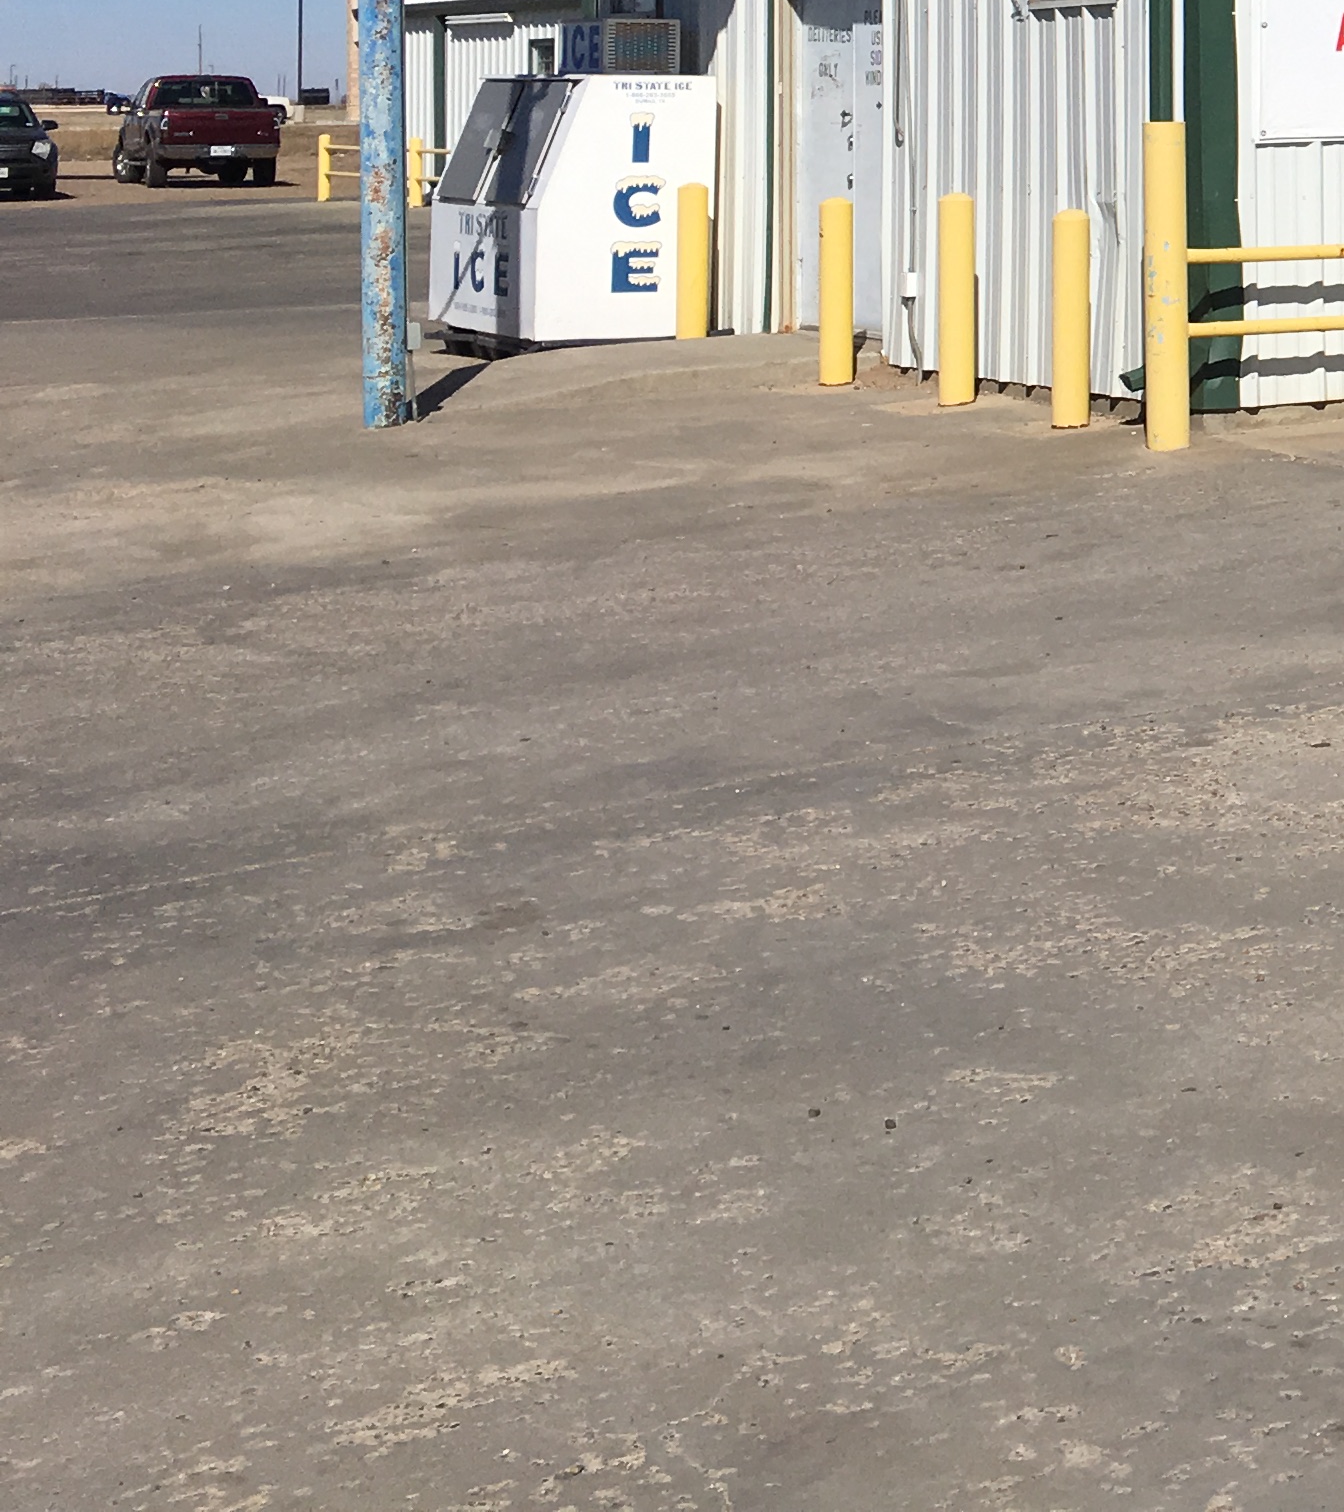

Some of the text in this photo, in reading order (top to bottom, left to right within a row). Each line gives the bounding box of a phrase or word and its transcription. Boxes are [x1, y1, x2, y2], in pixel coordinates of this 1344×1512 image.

[562, 24, 600, 69] ICE
[613, 81, 692, 90] TRI STATE ICE
[610, 111, 666, 293] ICE
[459, 210, 508, 240] TRI STATE
[453, 240, 510, 297] ICE
